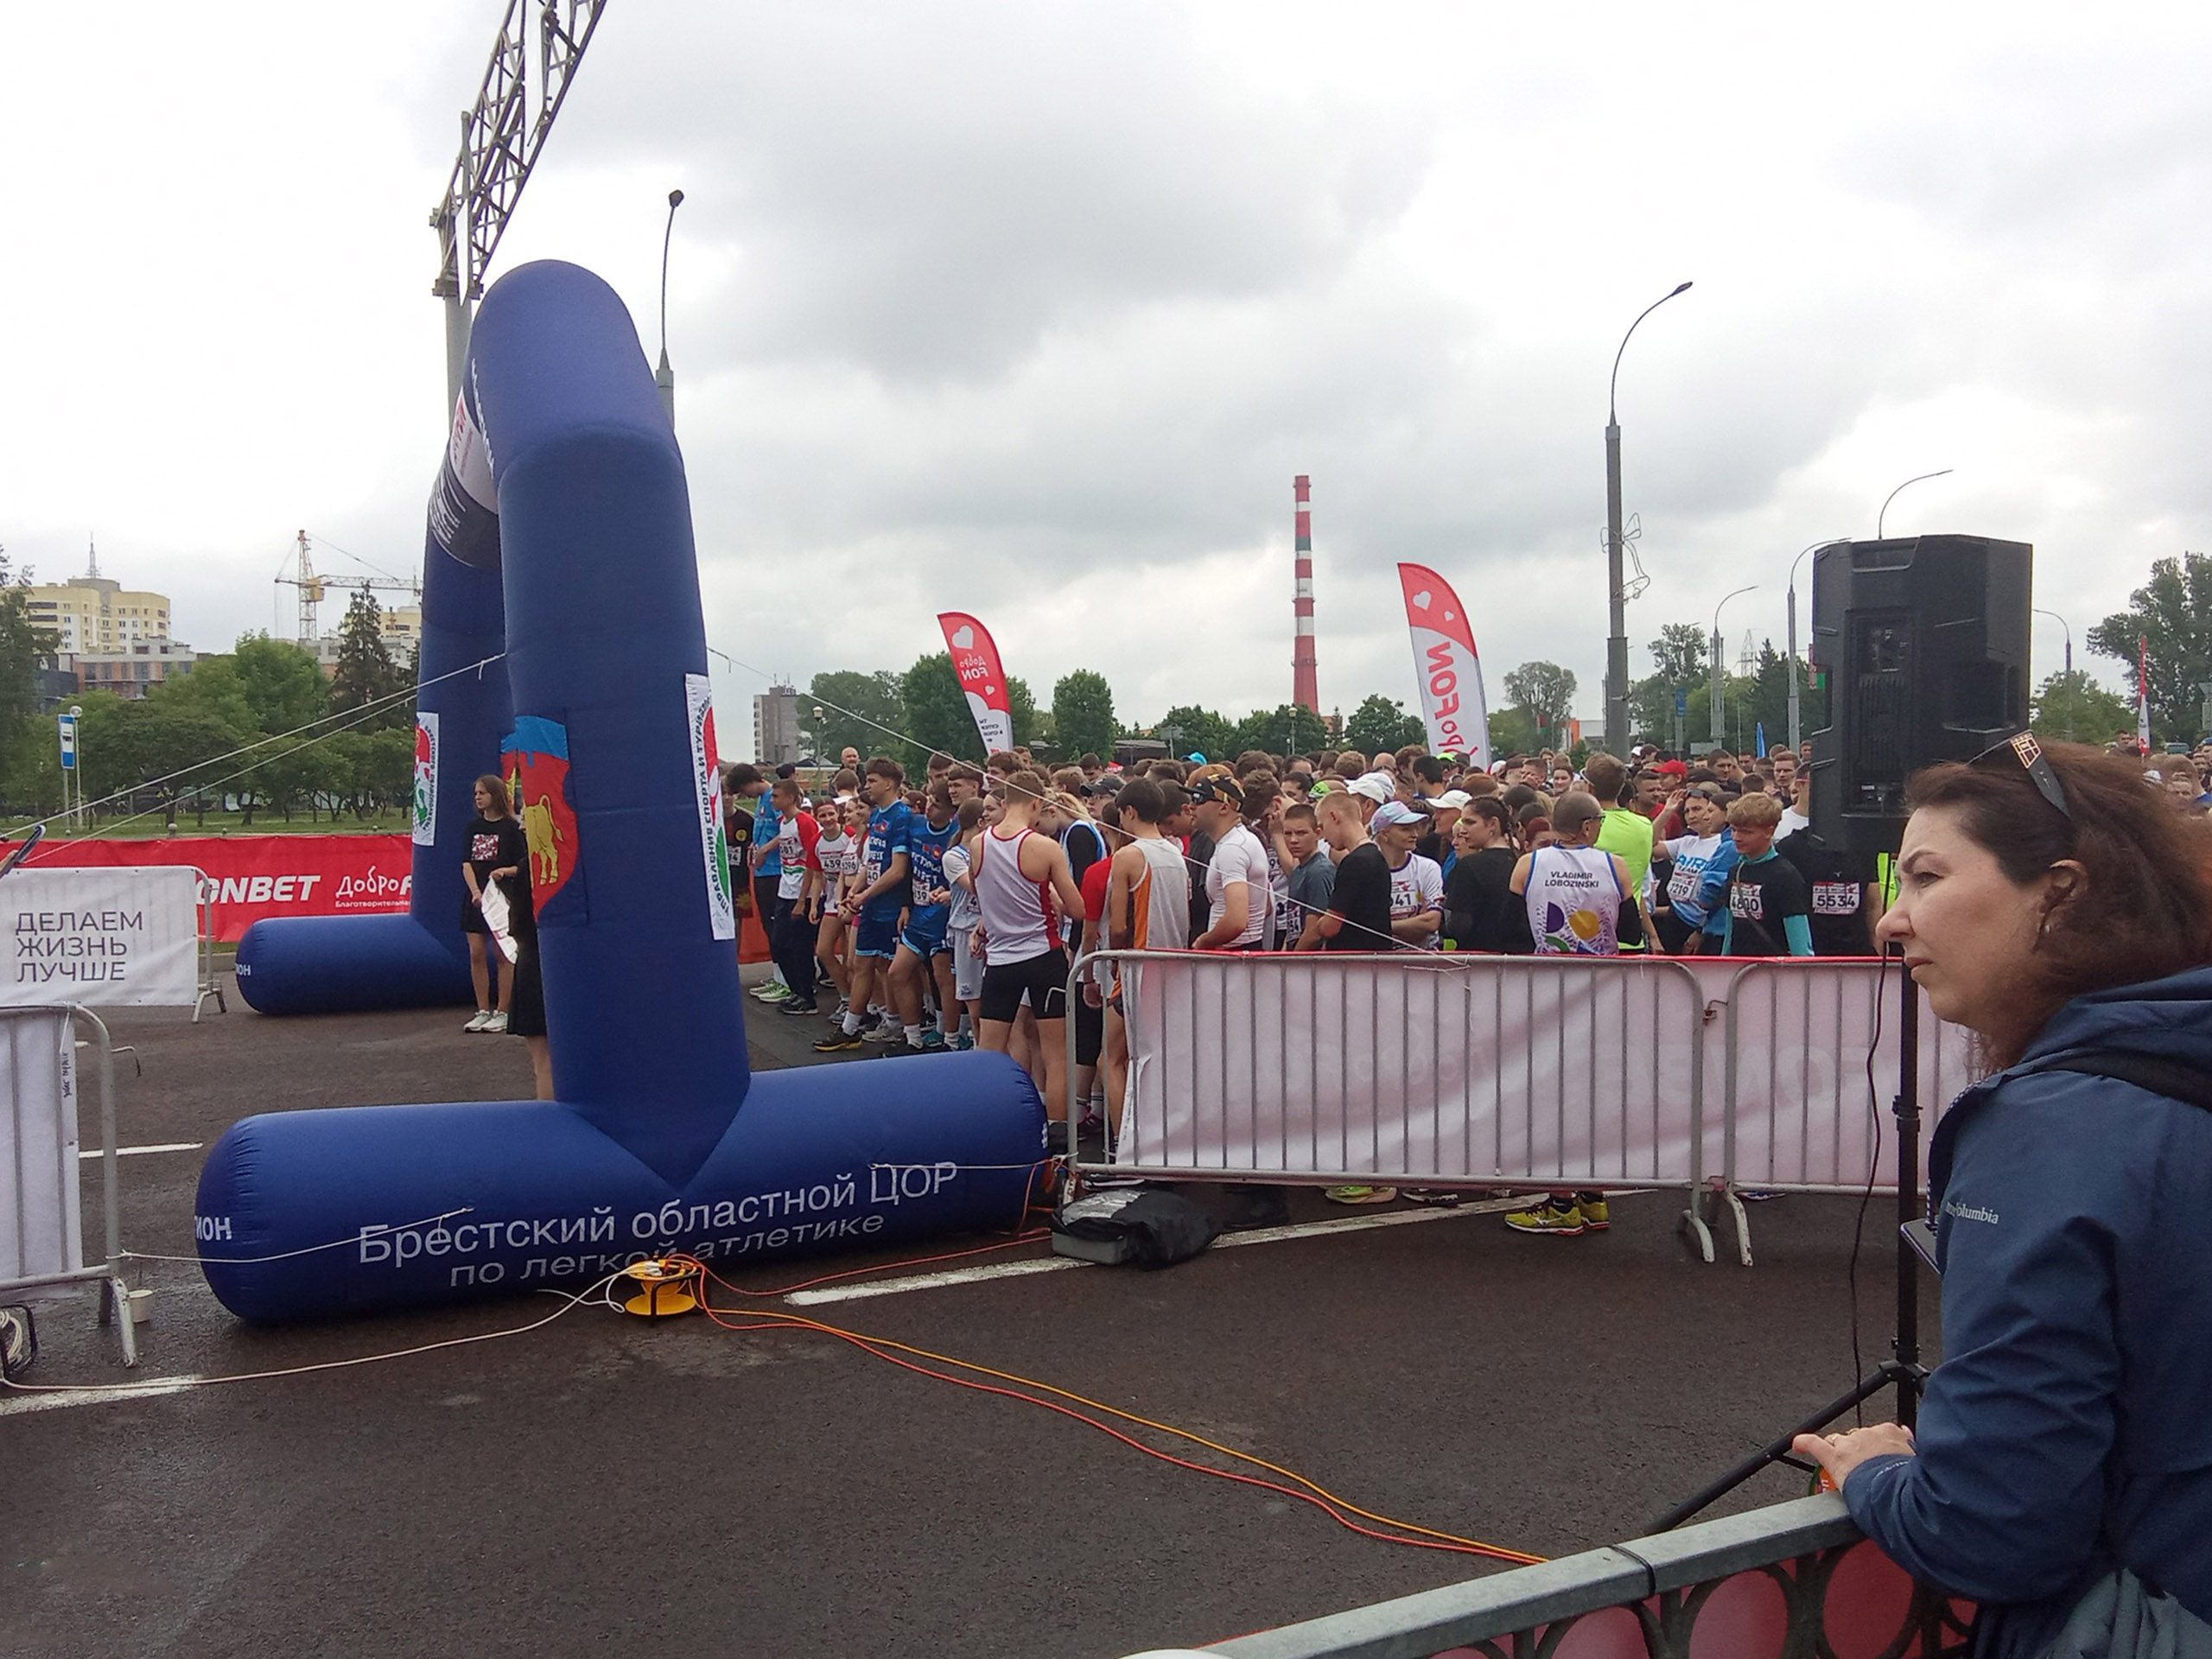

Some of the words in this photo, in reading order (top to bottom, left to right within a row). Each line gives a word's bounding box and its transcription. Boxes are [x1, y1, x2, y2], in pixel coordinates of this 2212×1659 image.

[699, 771, 711, 823] СПОРТА
[706, 827, 730, 917] УПРАВЛЕНИЕ
[1551, 871, 1593, 880] VLADIMIR
[1545, 879, 1599, 888] LOBOZINSKI
[1669, 883, 1689, 896] 1219
[1816, 894, 1856, 907] 5534
[16, 911, 143, 936] ДЕЛАЕМ
[17, 937, 127, 957] ЖИЗНЬ
[17, 962, 126, 982] ЛУЧШЕ
[359, 1206, 616, 1268] Брестский
[632, 1172, 856, 1239] областной
[869, 1161, 958, 1205] ЦОР
[194, 1217, 232, 1241] ИОН
[450, 1262, 505, 1287] по
[692, 1214, 885, 1261] атлетике
